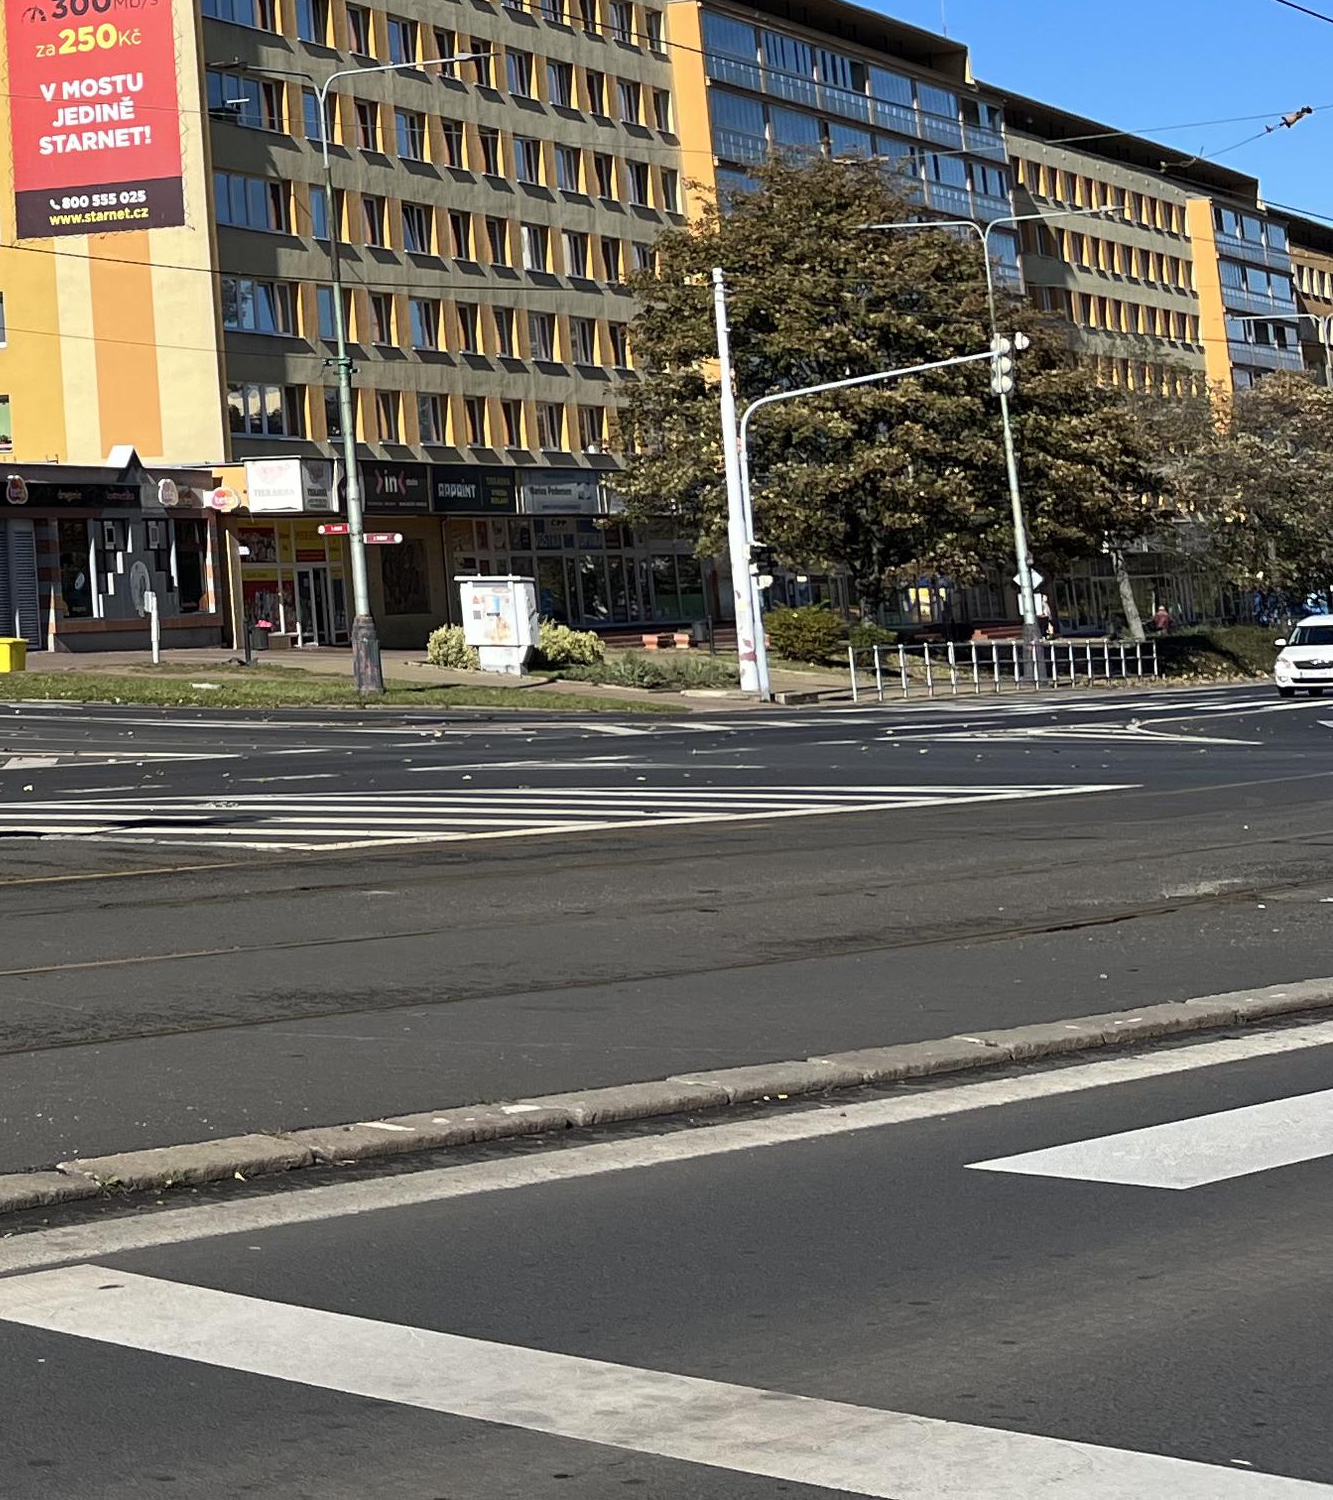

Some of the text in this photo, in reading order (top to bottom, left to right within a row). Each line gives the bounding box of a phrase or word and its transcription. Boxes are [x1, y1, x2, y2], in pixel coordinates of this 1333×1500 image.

[58, 23, 118, 55] 250
[39, 72, 144, 102] V MOSTU
[52, 96, 135, 127] JEDINĚ
[39, 125, 152, 155] STARNET!
[61, 190, 147, 209] 800 555 025
[49, 207, 149, 226] www.starnet.cz
